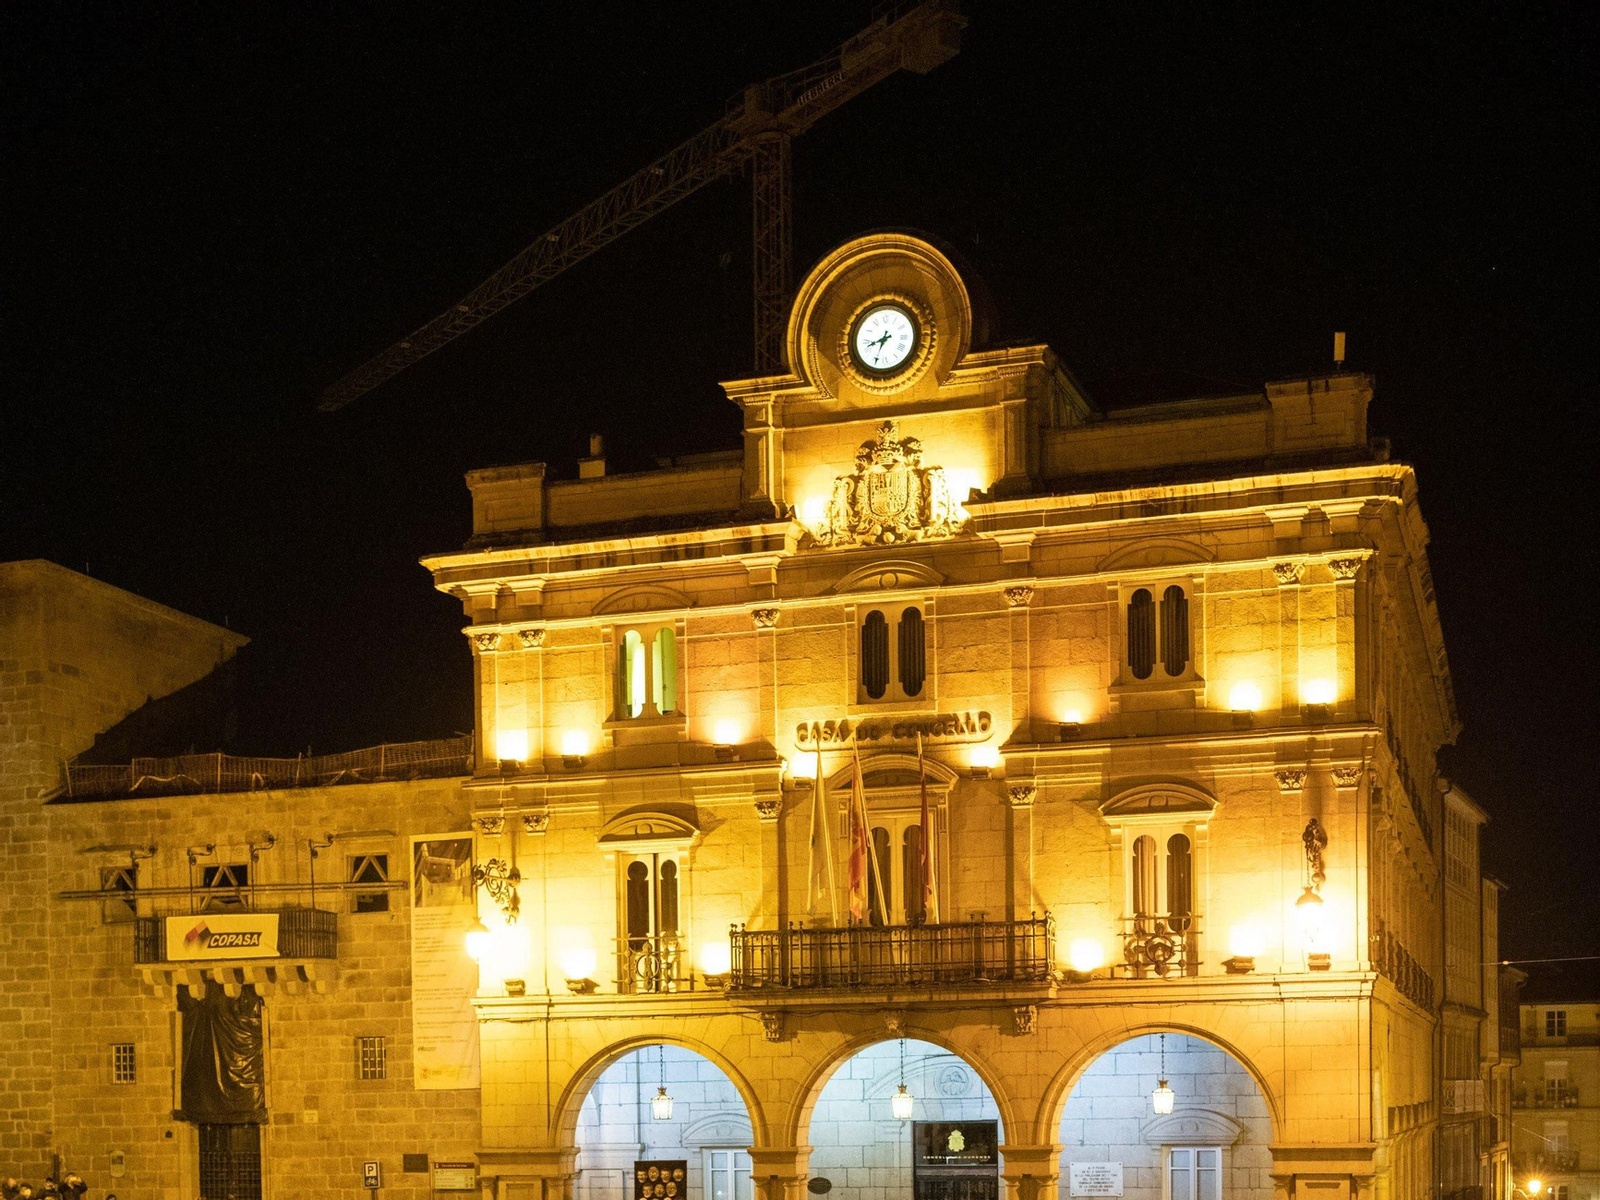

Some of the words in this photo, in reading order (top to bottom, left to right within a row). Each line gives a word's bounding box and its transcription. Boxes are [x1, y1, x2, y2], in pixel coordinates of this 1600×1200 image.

[797, 73, 843, 104] LIEBHERR
[796, 726, 843, 743] CASA
[857, 726, 880, 740] DO
[892, 717, 991, 739] CONCELLO
[210, 934, 259, 946] COPASA
[368, 1166, 374, 1175] P
